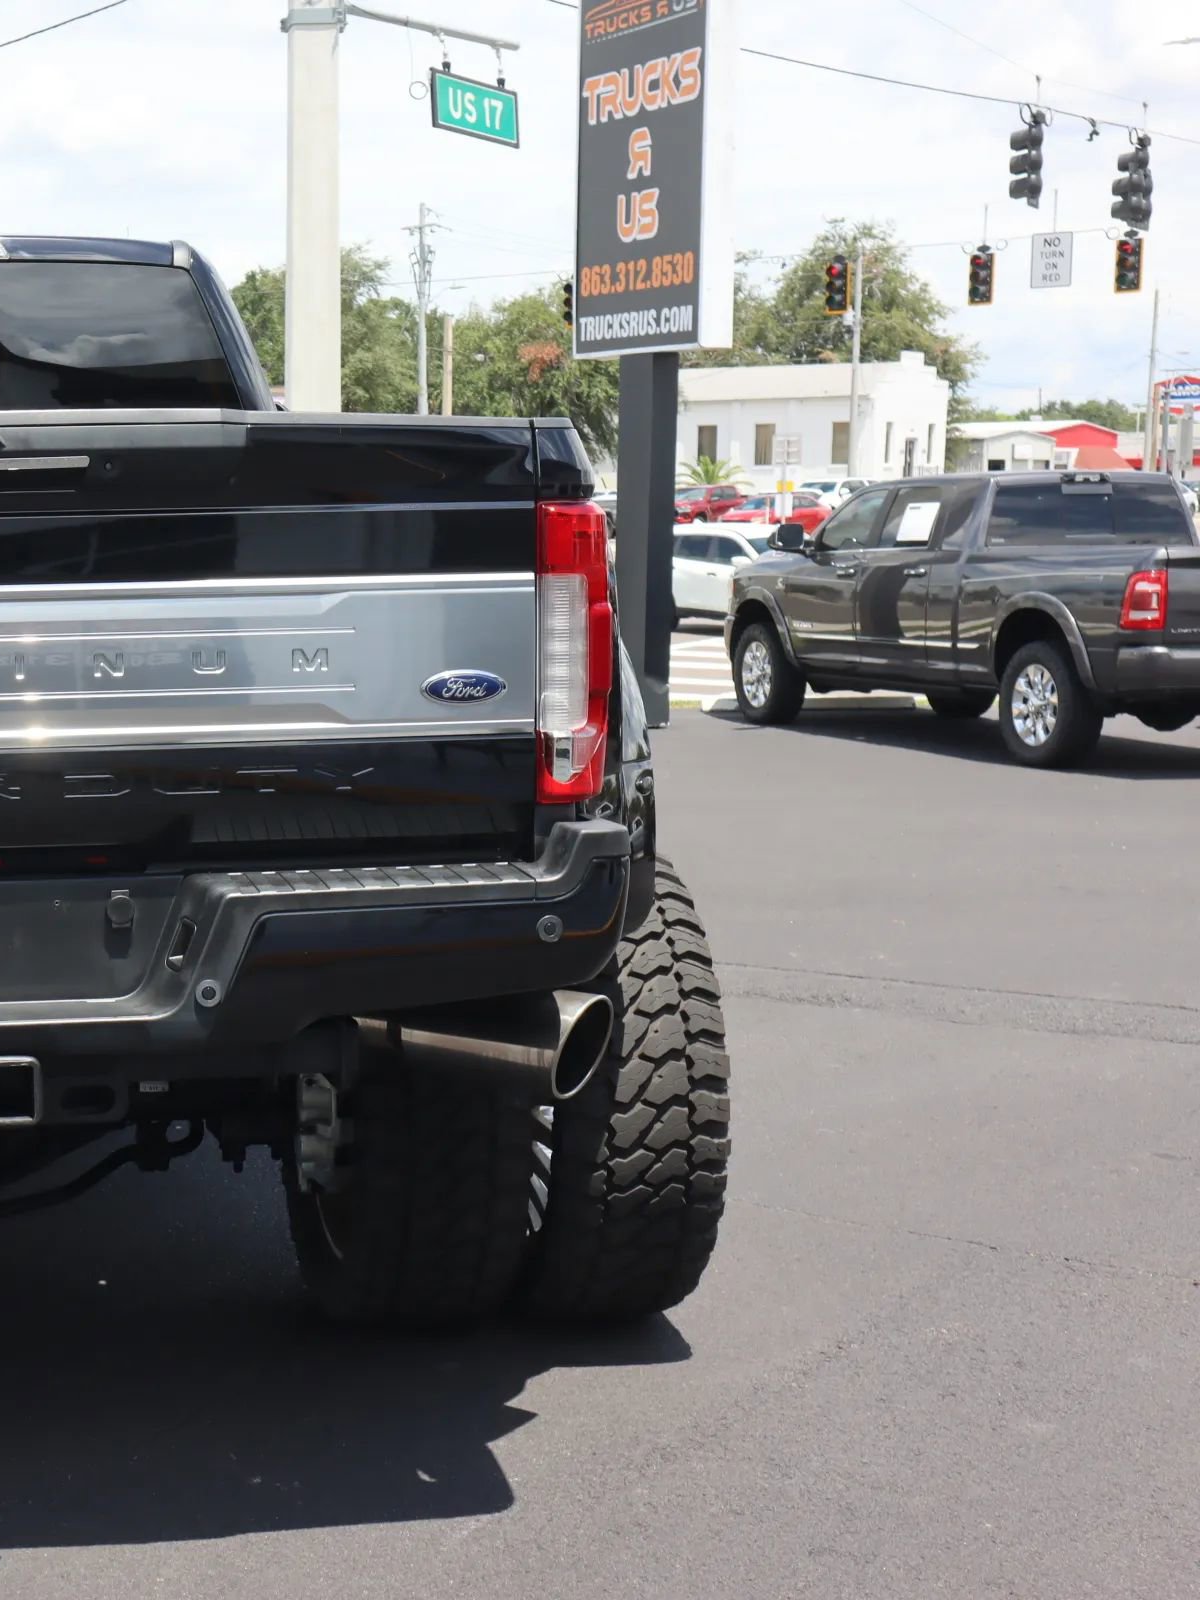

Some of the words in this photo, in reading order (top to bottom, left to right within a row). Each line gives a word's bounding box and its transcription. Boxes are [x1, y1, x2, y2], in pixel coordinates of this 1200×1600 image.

[585, 6, 652, 39] TRUCKS
[582, 46, 702, 126] TRUCKS
[448, 86, 478, 124] US
[483, 97, 504, 130] 17
[617, 187, 660, 243] US
[1040, 249, 1065, 260] TURN
[1043, 236, 1061, 248] NO
[580, 250, 695, 297] 863.312.8530
[1041, 272, 1061, 282] RED
[1045, 261, 1058, 271] ON
[579, 304, 693, 342] TRUCKSRUS.COM
[64, 763, 375, 799] DUTY
